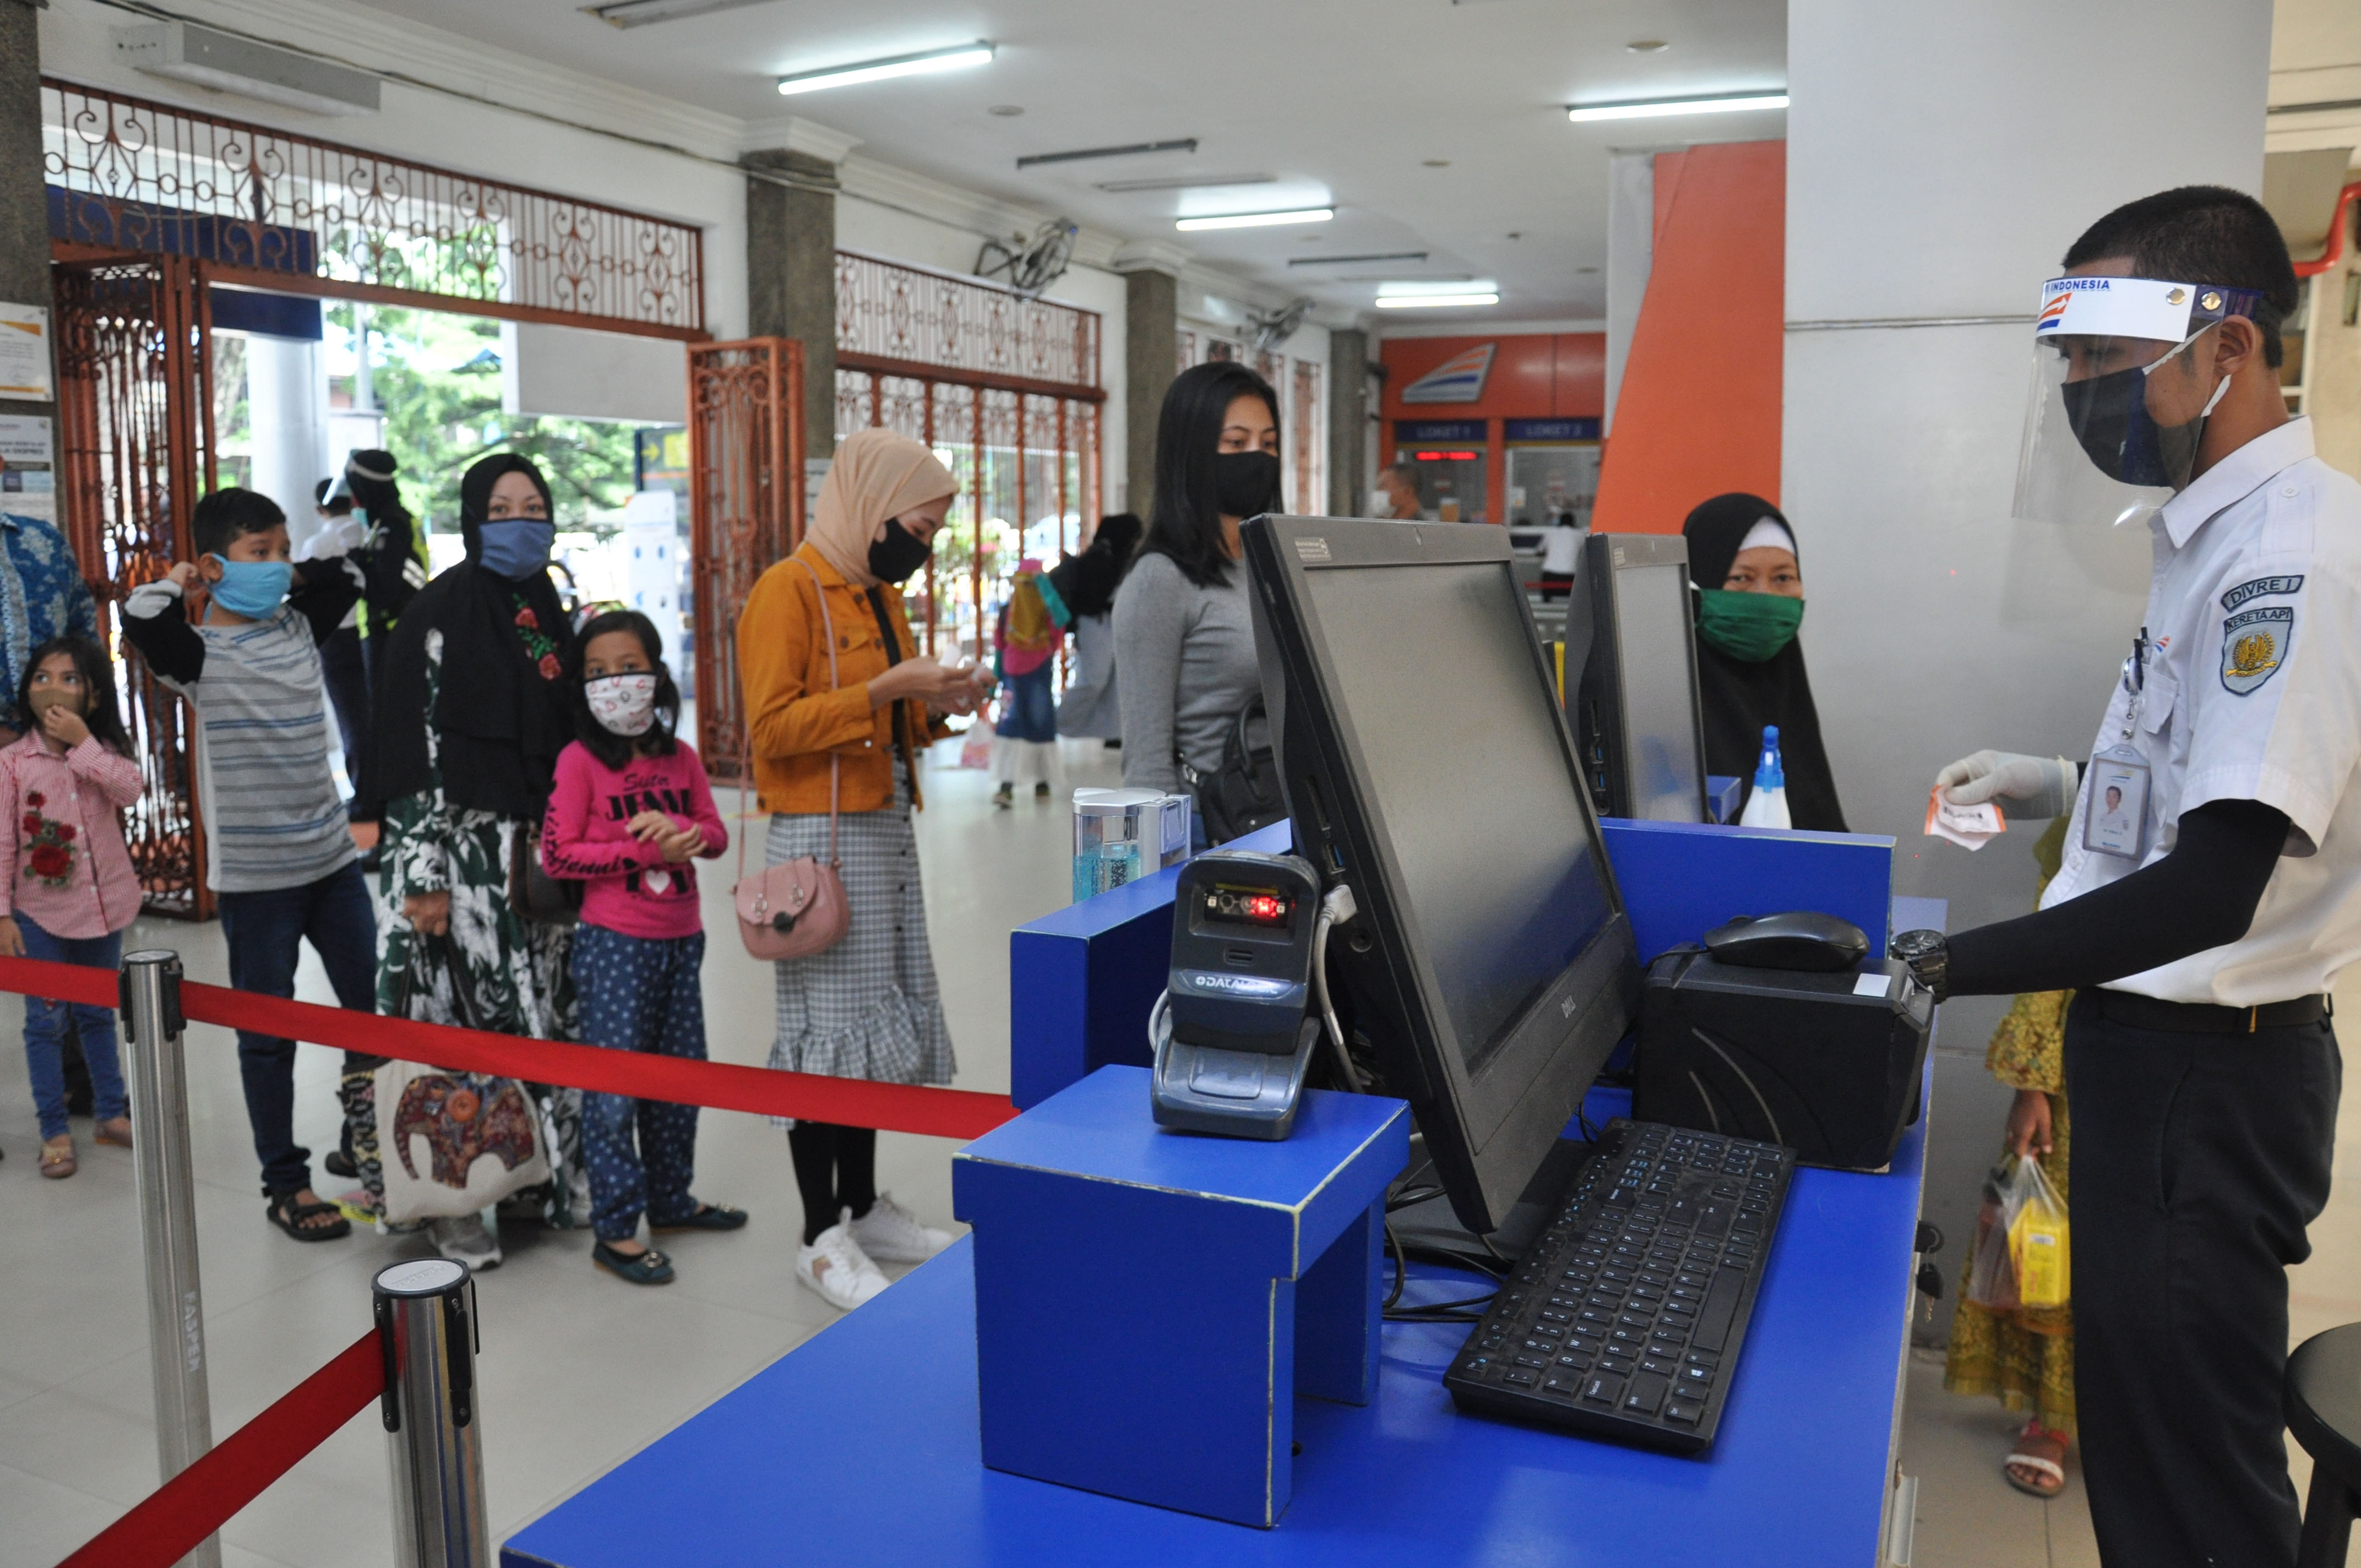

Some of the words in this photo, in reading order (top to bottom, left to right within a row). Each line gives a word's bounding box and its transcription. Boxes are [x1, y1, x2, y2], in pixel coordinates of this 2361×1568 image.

[2050, 280, 2109, 292] INDONESIA
[2231, 580, 2280, 604] DIVRE
[2226, 611, 2267, 630] KERETA
[2268, 609, 2289, 619] API
